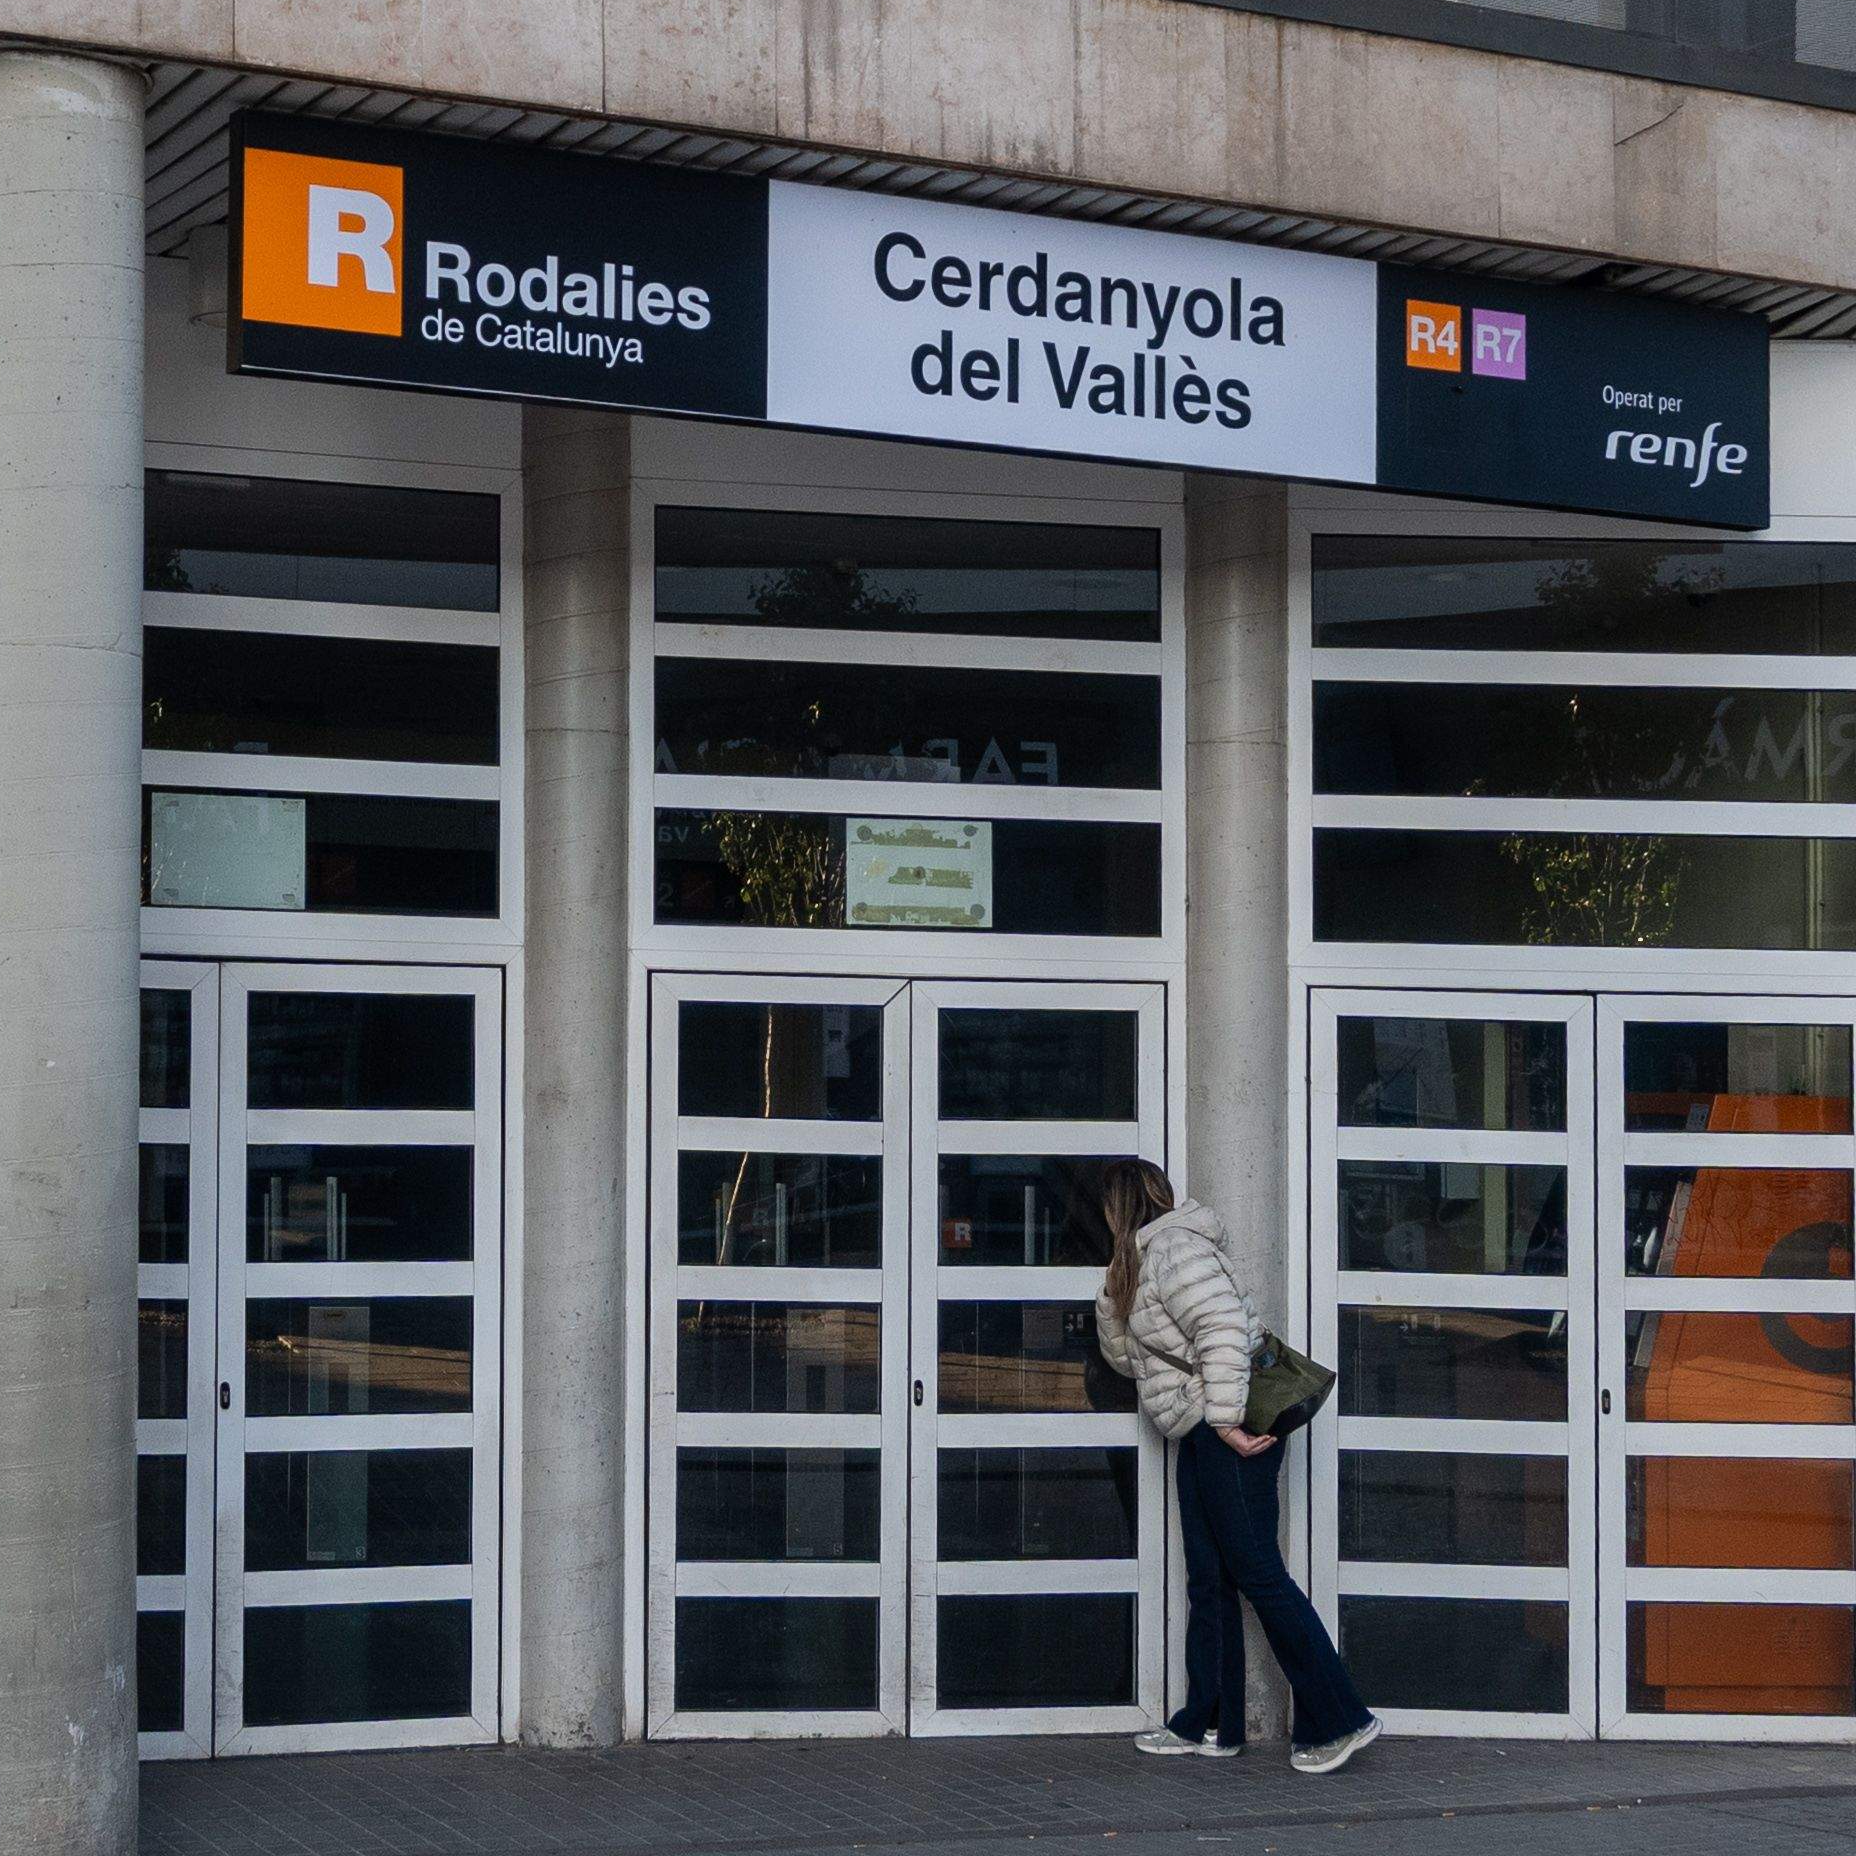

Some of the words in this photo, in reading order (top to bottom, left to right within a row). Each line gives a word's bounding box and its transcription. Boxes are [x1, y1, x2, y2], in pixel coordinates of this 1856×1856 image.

[307, 183, 396, 294] R
[425, 240, 712, 330] Rodalies
[873, 231, 1286, 350] Cerdanyola
[421, 308, 465, 343] de
[475, 313, 644, 368] Catalunya
[1410, 315, 1458, 356] R4
[1475, 323, 1522, 364] R7
[910, 329, 1020, 404] del
[1042, 340, 1252, 430] Vallès
[1602, 384, 1655, 411] Operat
[1658, 395, 1683, 415] per
[1605, 422, 1748, 488] renfe
